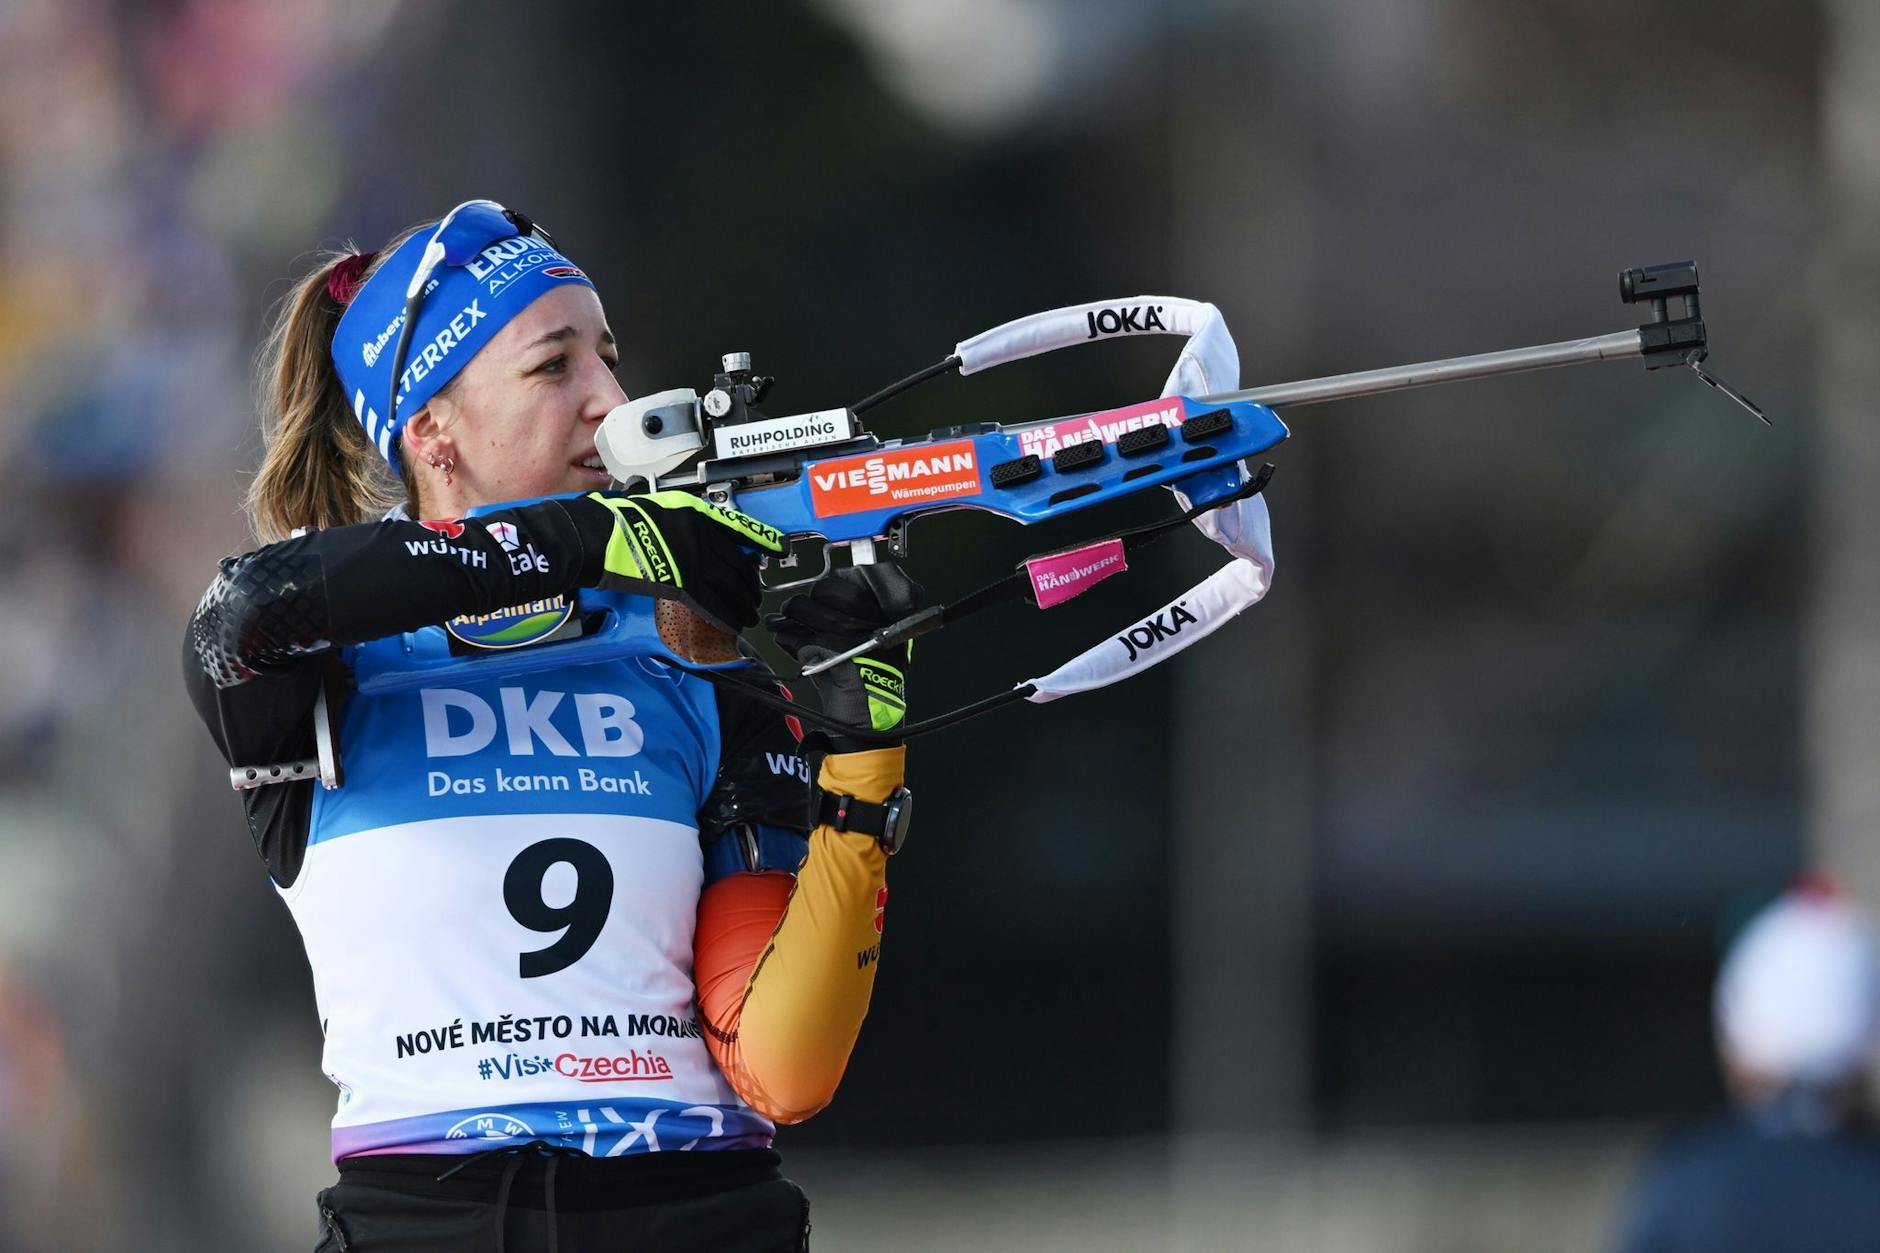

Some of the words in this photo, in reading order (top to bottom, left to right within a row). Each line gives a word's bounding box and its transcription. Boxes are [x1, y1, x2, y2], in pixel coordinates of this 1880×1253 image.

[1087, 305, 1167, 339] JOKA
[400, 298, 488, 392] TERREX
[730, 422, 835, 449] RUHPOLDING
[1021, 426, 1056, 443] DAS
[813, 452, 973, 495] VIESSMANN
[891, 479, 977, 500] Wärmepumpen
[1036, 571, 1056, 582] DAS
[1117, 602, 1198, 662] JOKA
[420, 687, 644, 758] DKB
[428, 771, 486, 796] Das
[496, 768, 569, 792] kann
[577, 768, 652, 796] Bank
[503, 837, 614, 978] 9
[396, 1018, 464, 1058] NOVÉ
[471, 1014, 573, 1044] MĚSTO
[581, 1016, 619, 1037] NA
